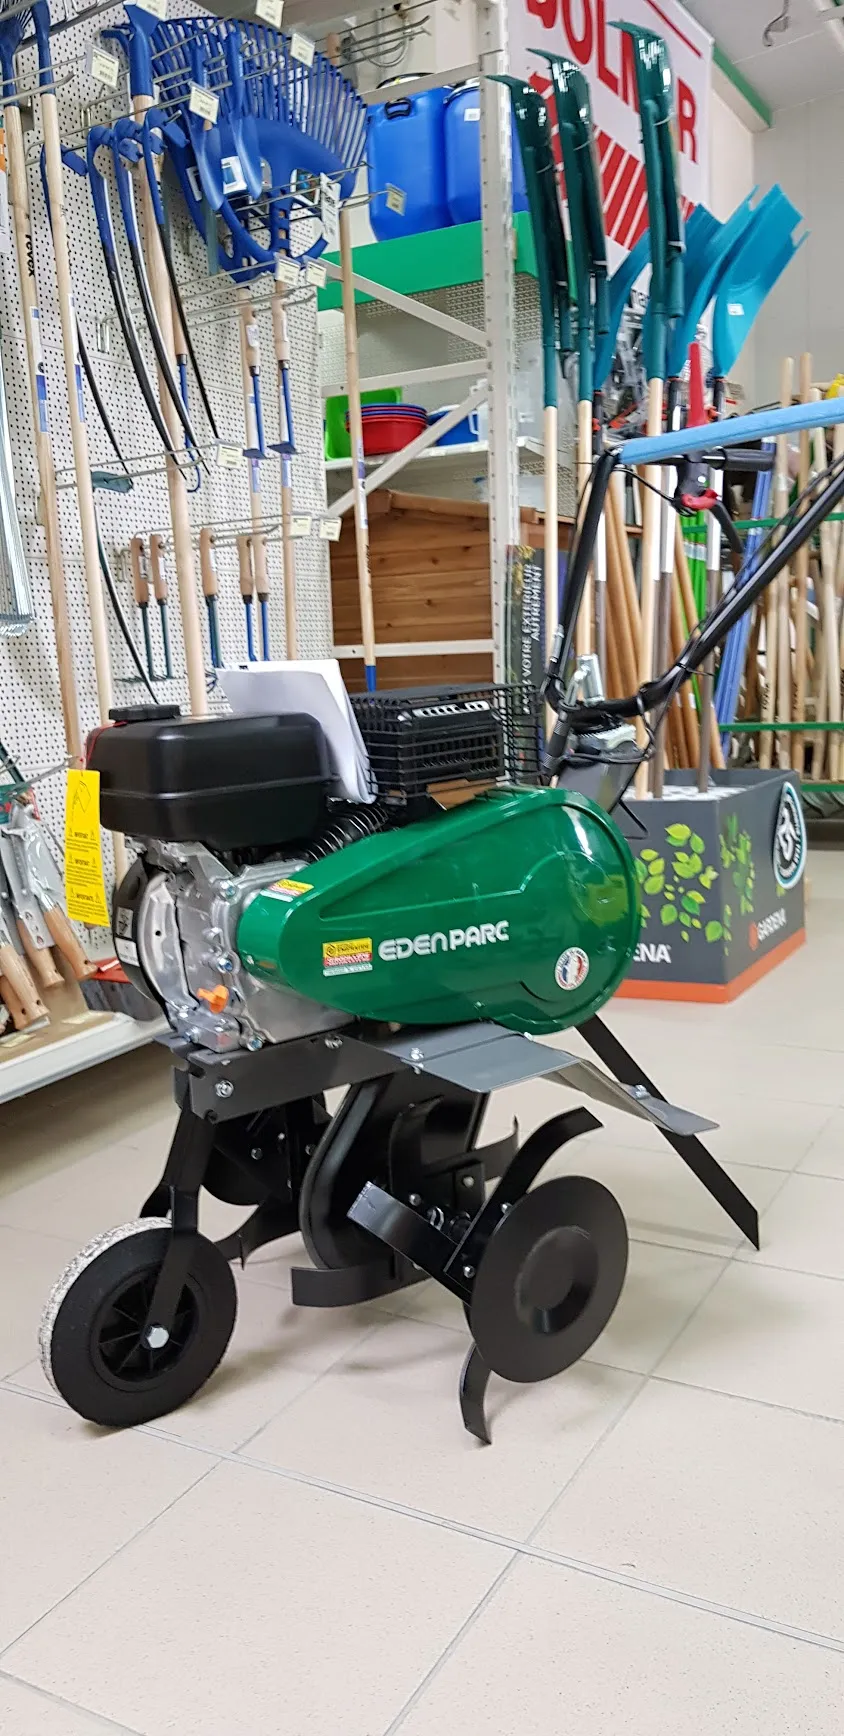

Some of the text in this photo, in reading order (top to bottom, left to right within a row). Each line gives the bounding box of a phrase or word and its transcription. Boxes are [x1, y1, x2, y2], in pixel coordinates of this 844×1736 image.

[527, 0, 698, 164] OLMR
[530, 566, 542, 641] AUTREMENT
[521, 636, 533, 678] VOTRE
